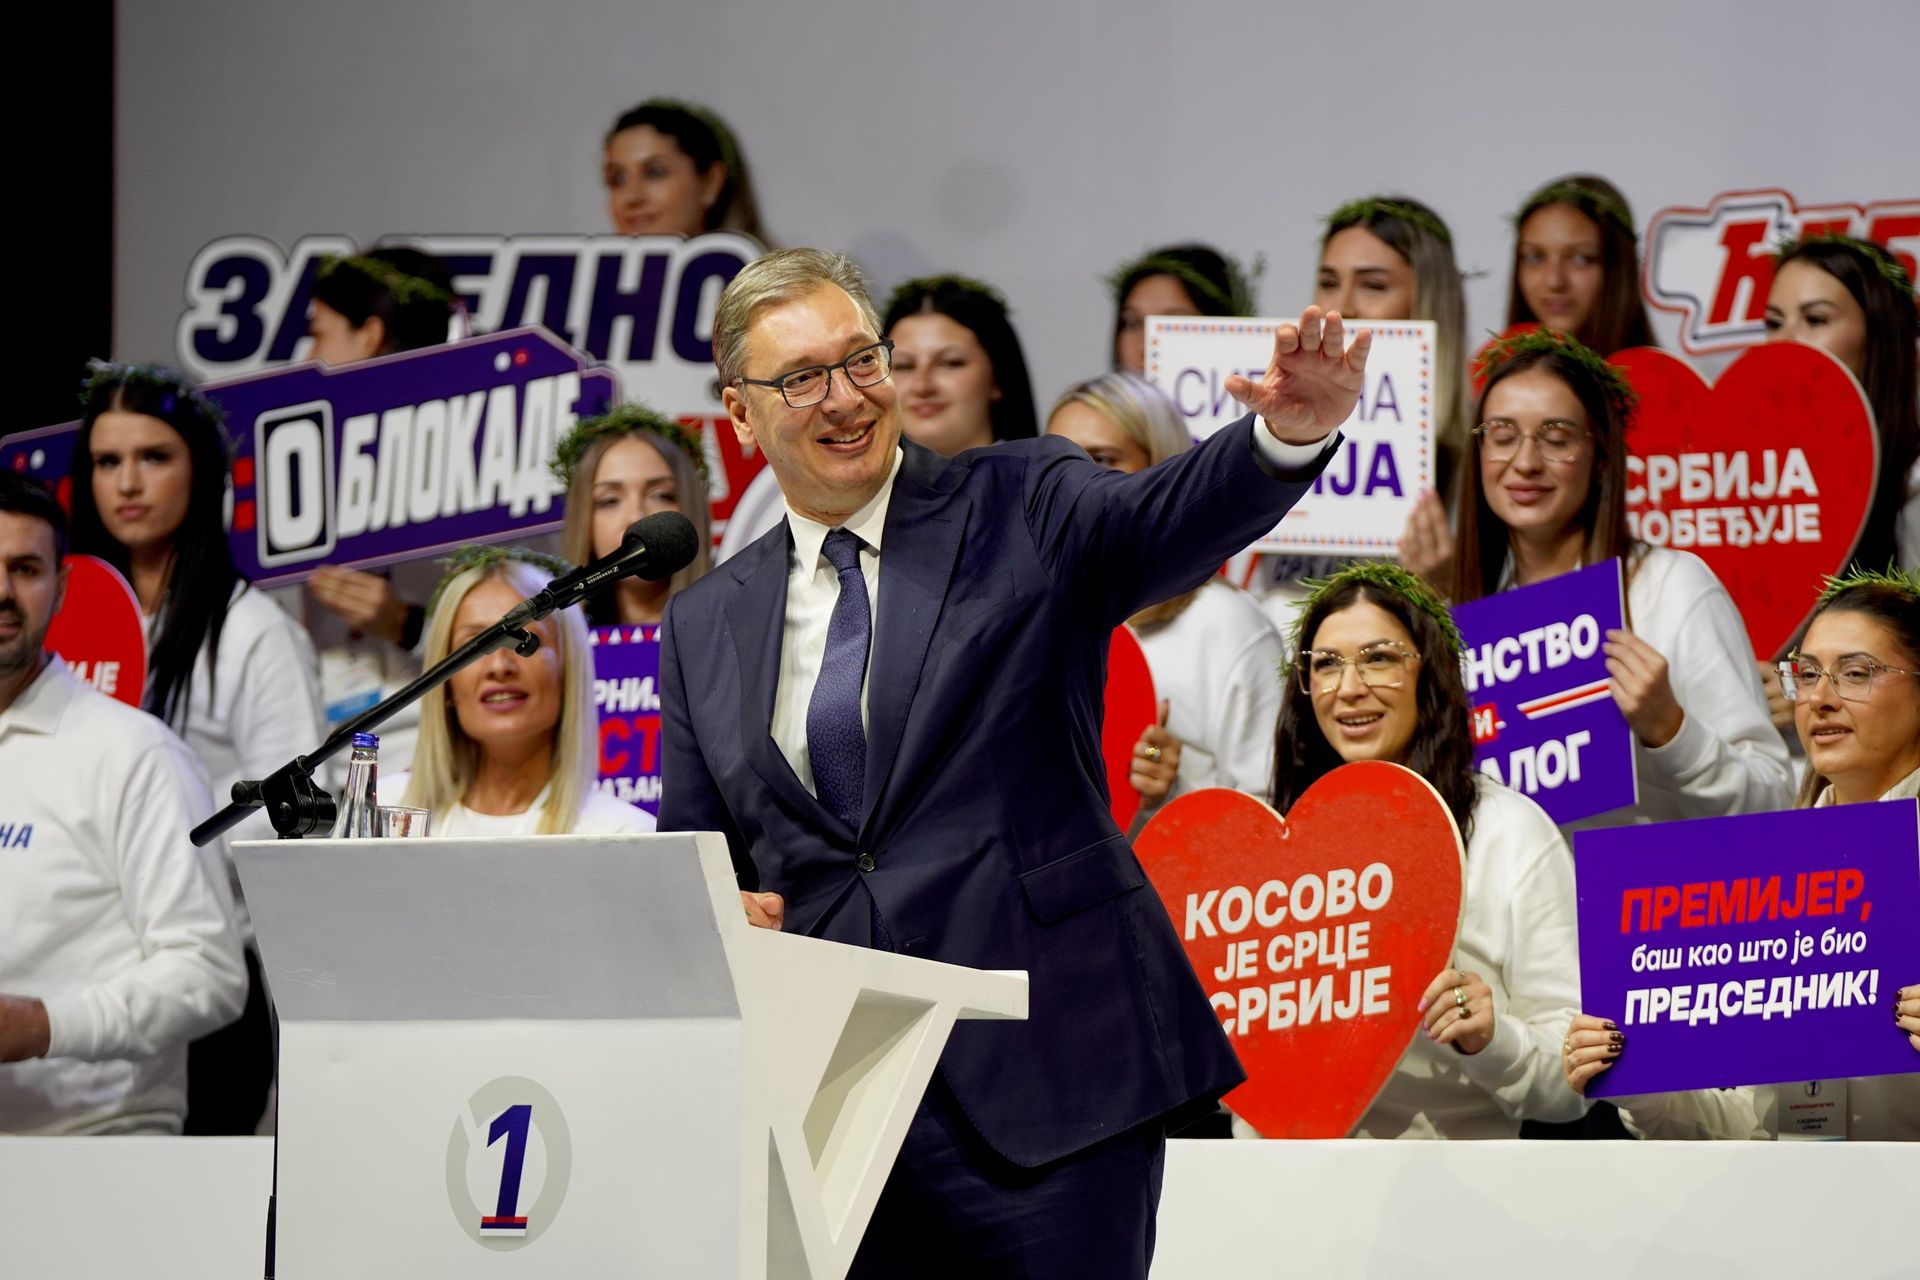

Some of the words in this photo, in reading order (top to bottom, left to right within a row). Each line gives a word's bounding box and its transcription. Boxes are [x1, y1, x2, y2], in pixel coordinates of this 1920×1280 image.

[337, 371, 581, 539] БЛОКАДЕ
[1459, 613, 1600, 692] НСТВО
[1184, 862, 1394, 941] КОСОВО
[1619, 867, 1873, 934] ПРЕМИЈЕР,
[1213, 939, 1260, 982] ЈЕ
[1265, 920, 1371, 973] СРЦЕ
[1631, 943, 1683, 973] баш
[1688, 942, 1733, 968] као
[1738, 937, 1788, 964] што
[1790, 929, 1815, 966] је
[1820, 926, 1868, 956] био
[1209, 965, 1392, 1036] СРБИЈЕ
[1624, 968, 1880, 1027] ПРЕДСЕДНИК!
